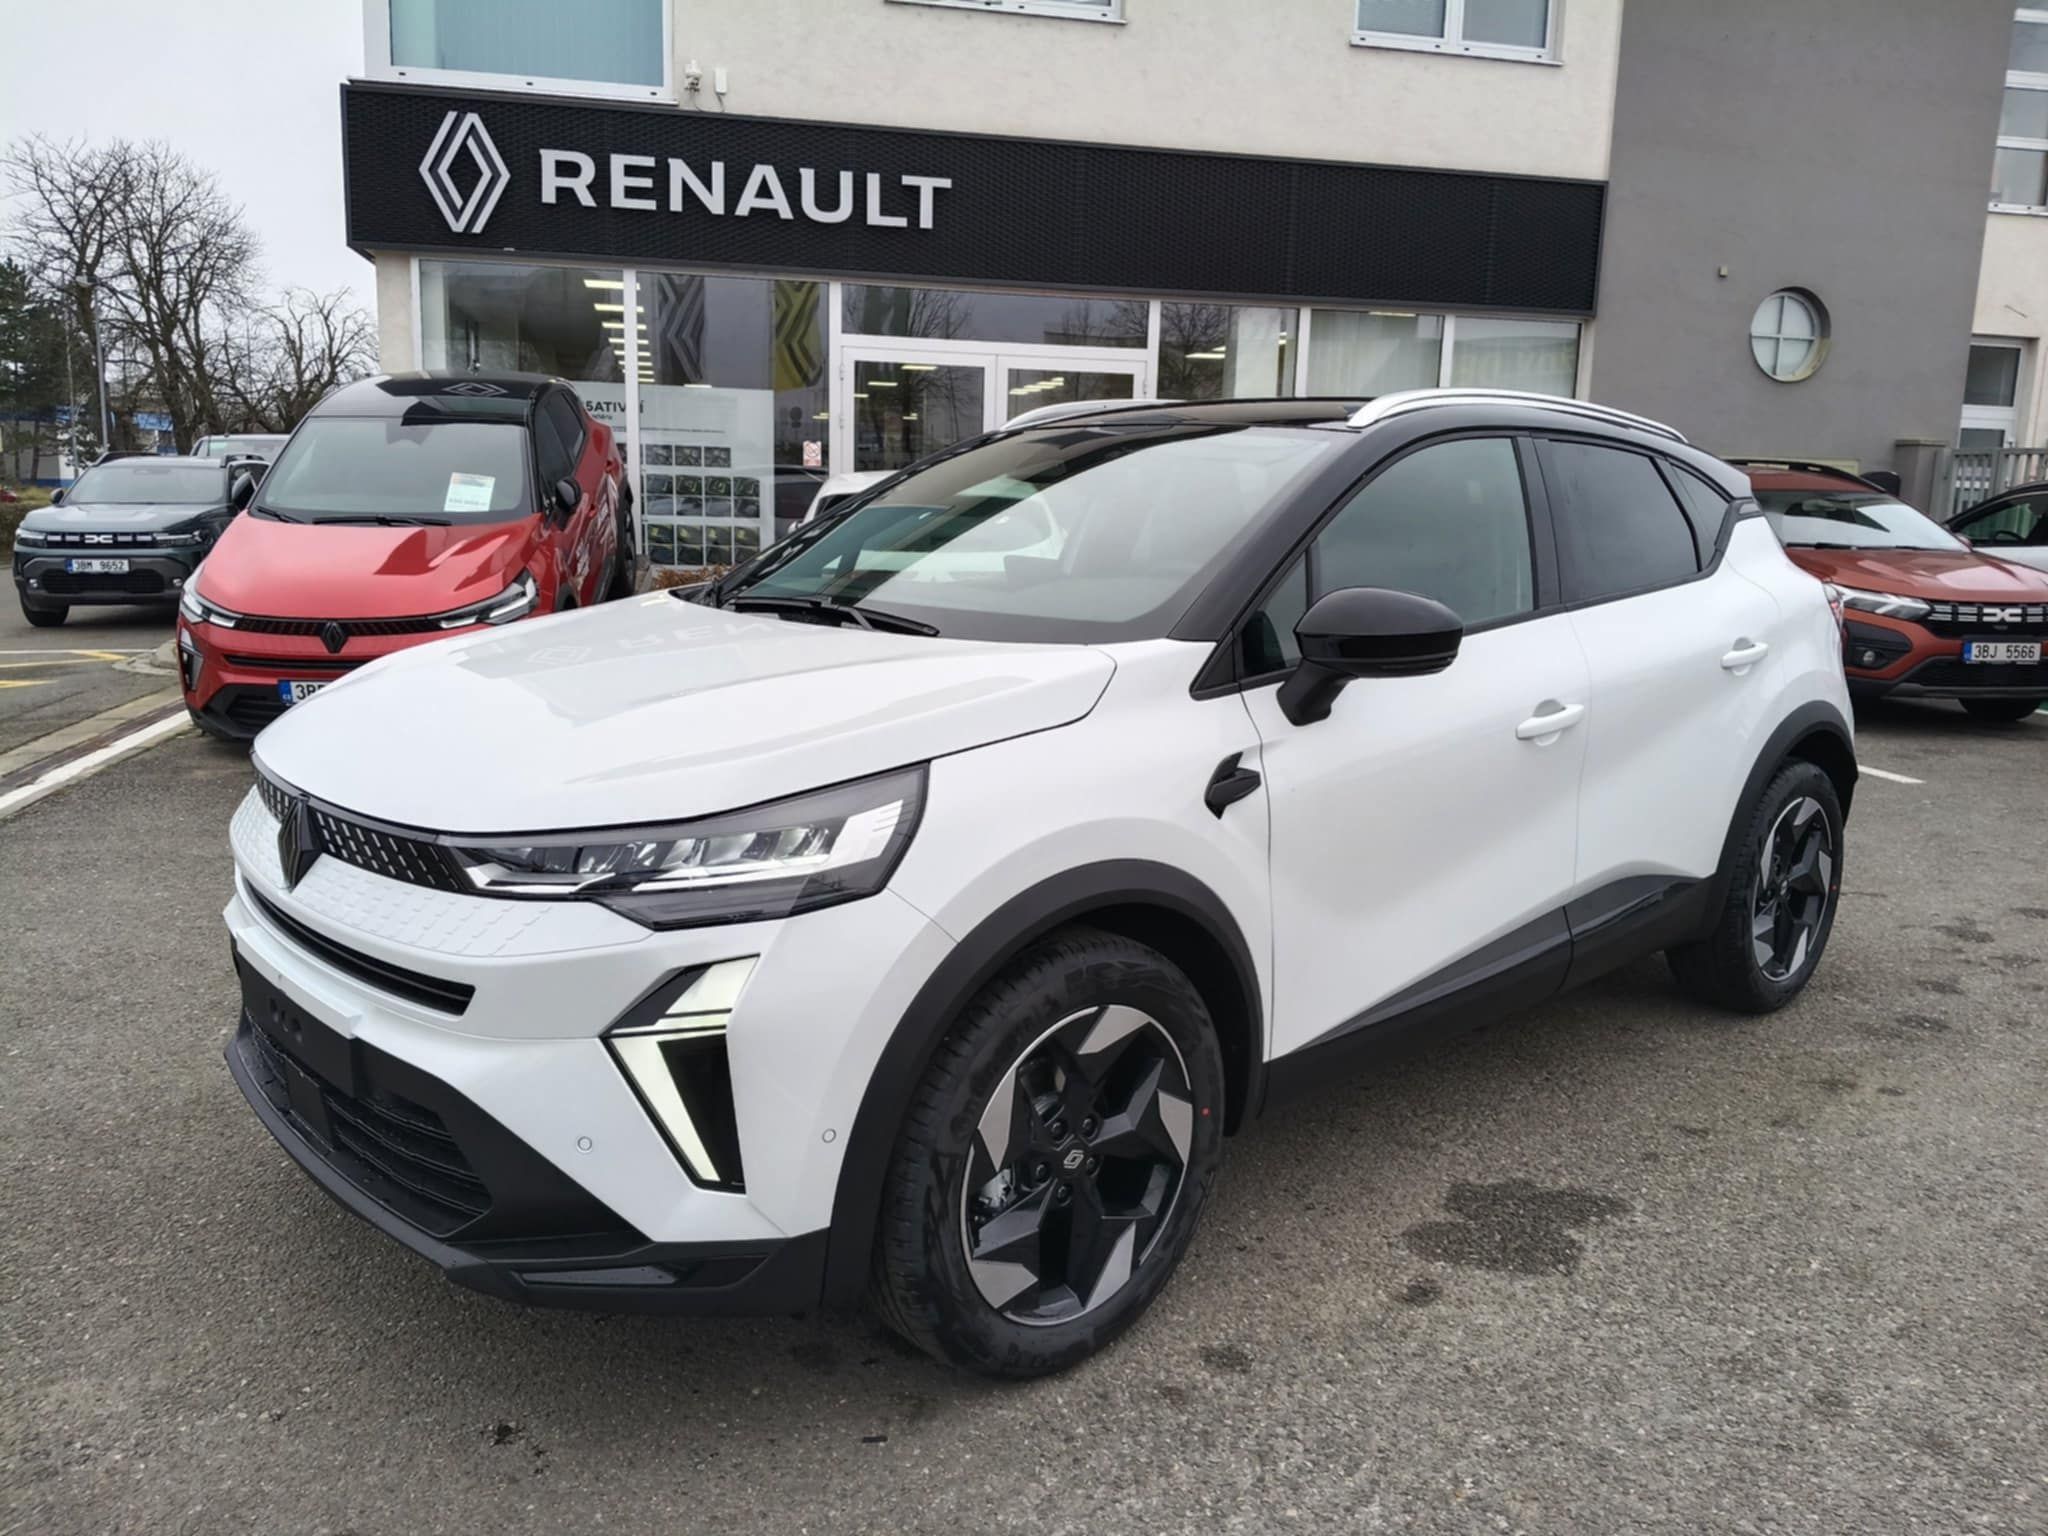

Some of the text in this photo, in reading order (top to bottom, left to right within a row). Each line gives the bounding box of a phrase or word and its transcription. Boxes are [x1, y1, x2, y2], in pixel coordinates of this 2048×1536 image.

[539, 148, 953, 229] RENAULT
[99, 560, 124, 570] 9652
[1974, 644, 2036, 659] 3BJ 5566
